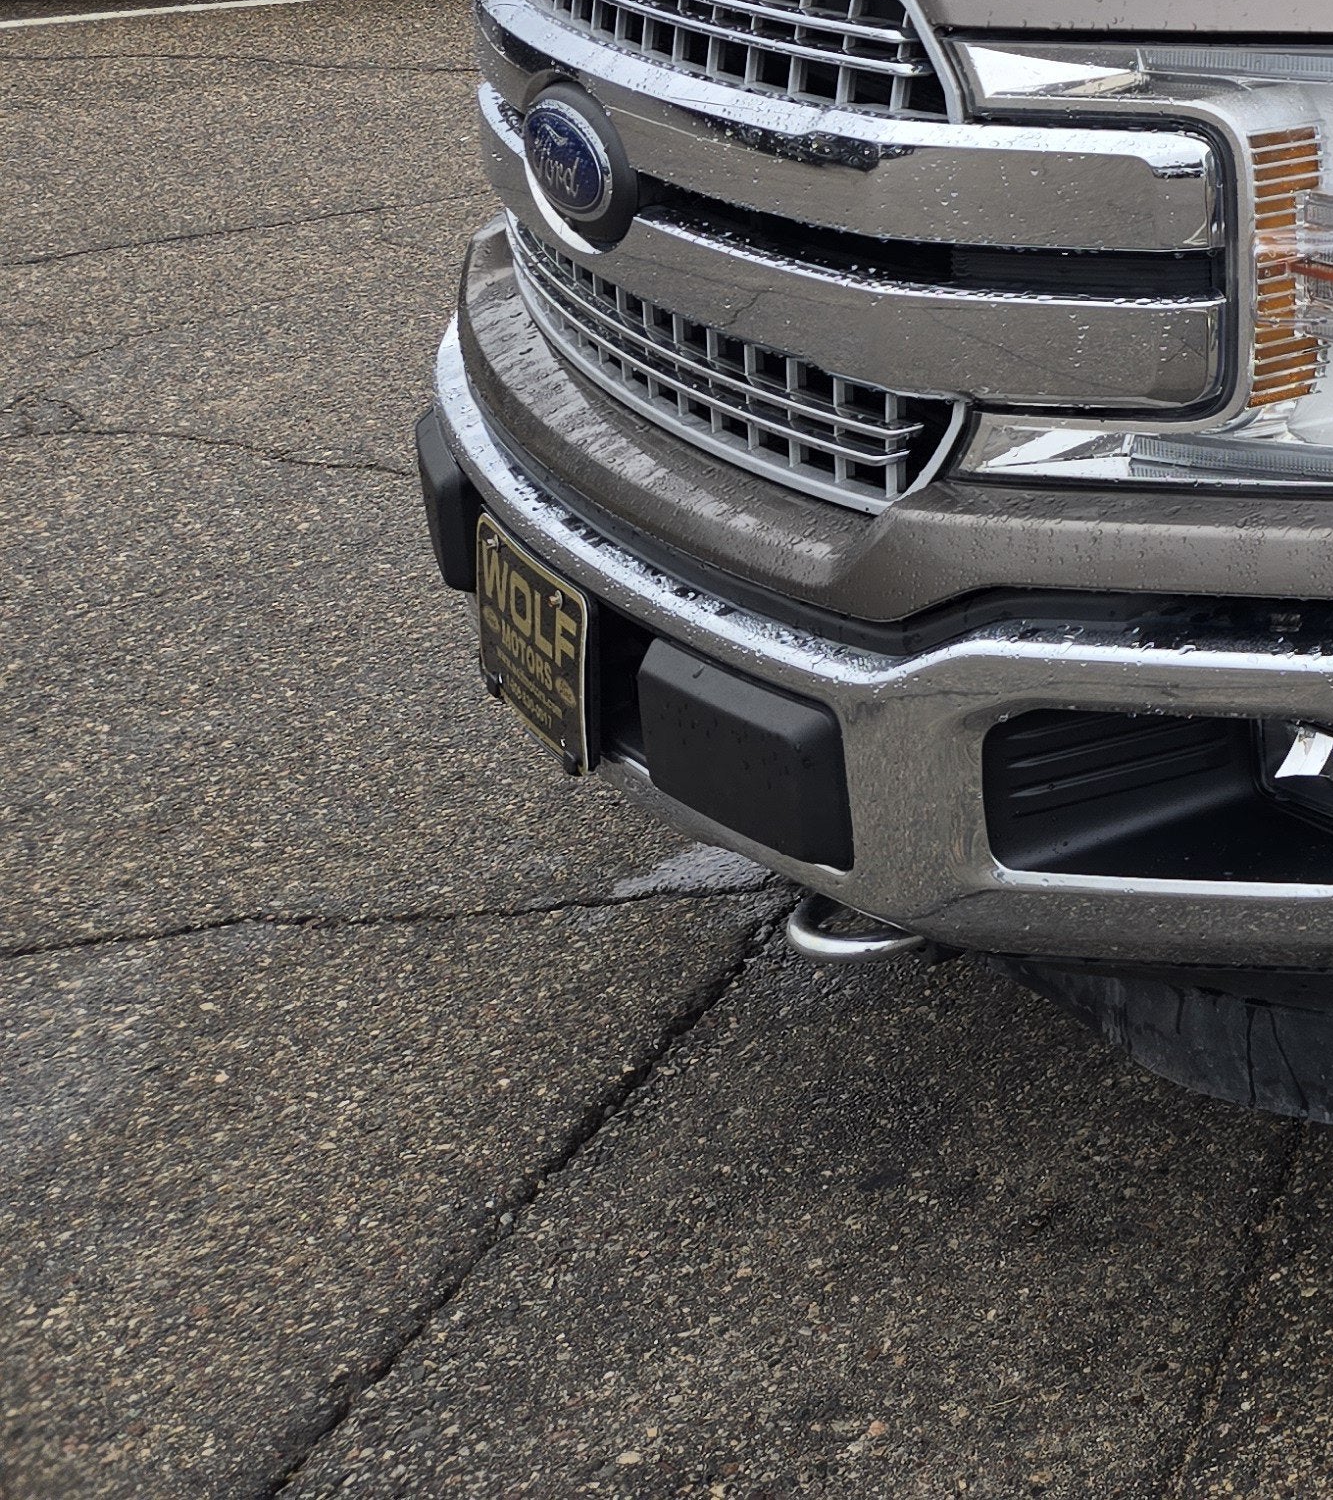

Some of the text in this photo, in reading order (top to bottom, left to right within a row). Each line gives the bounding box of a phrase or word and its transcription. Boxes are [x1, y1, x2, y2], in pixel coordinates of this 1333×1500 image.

[532, 122, 581, 199] Ford
[482, 538, 577, 668] WOLF
[501, 618, 553, 692] MOTORS
